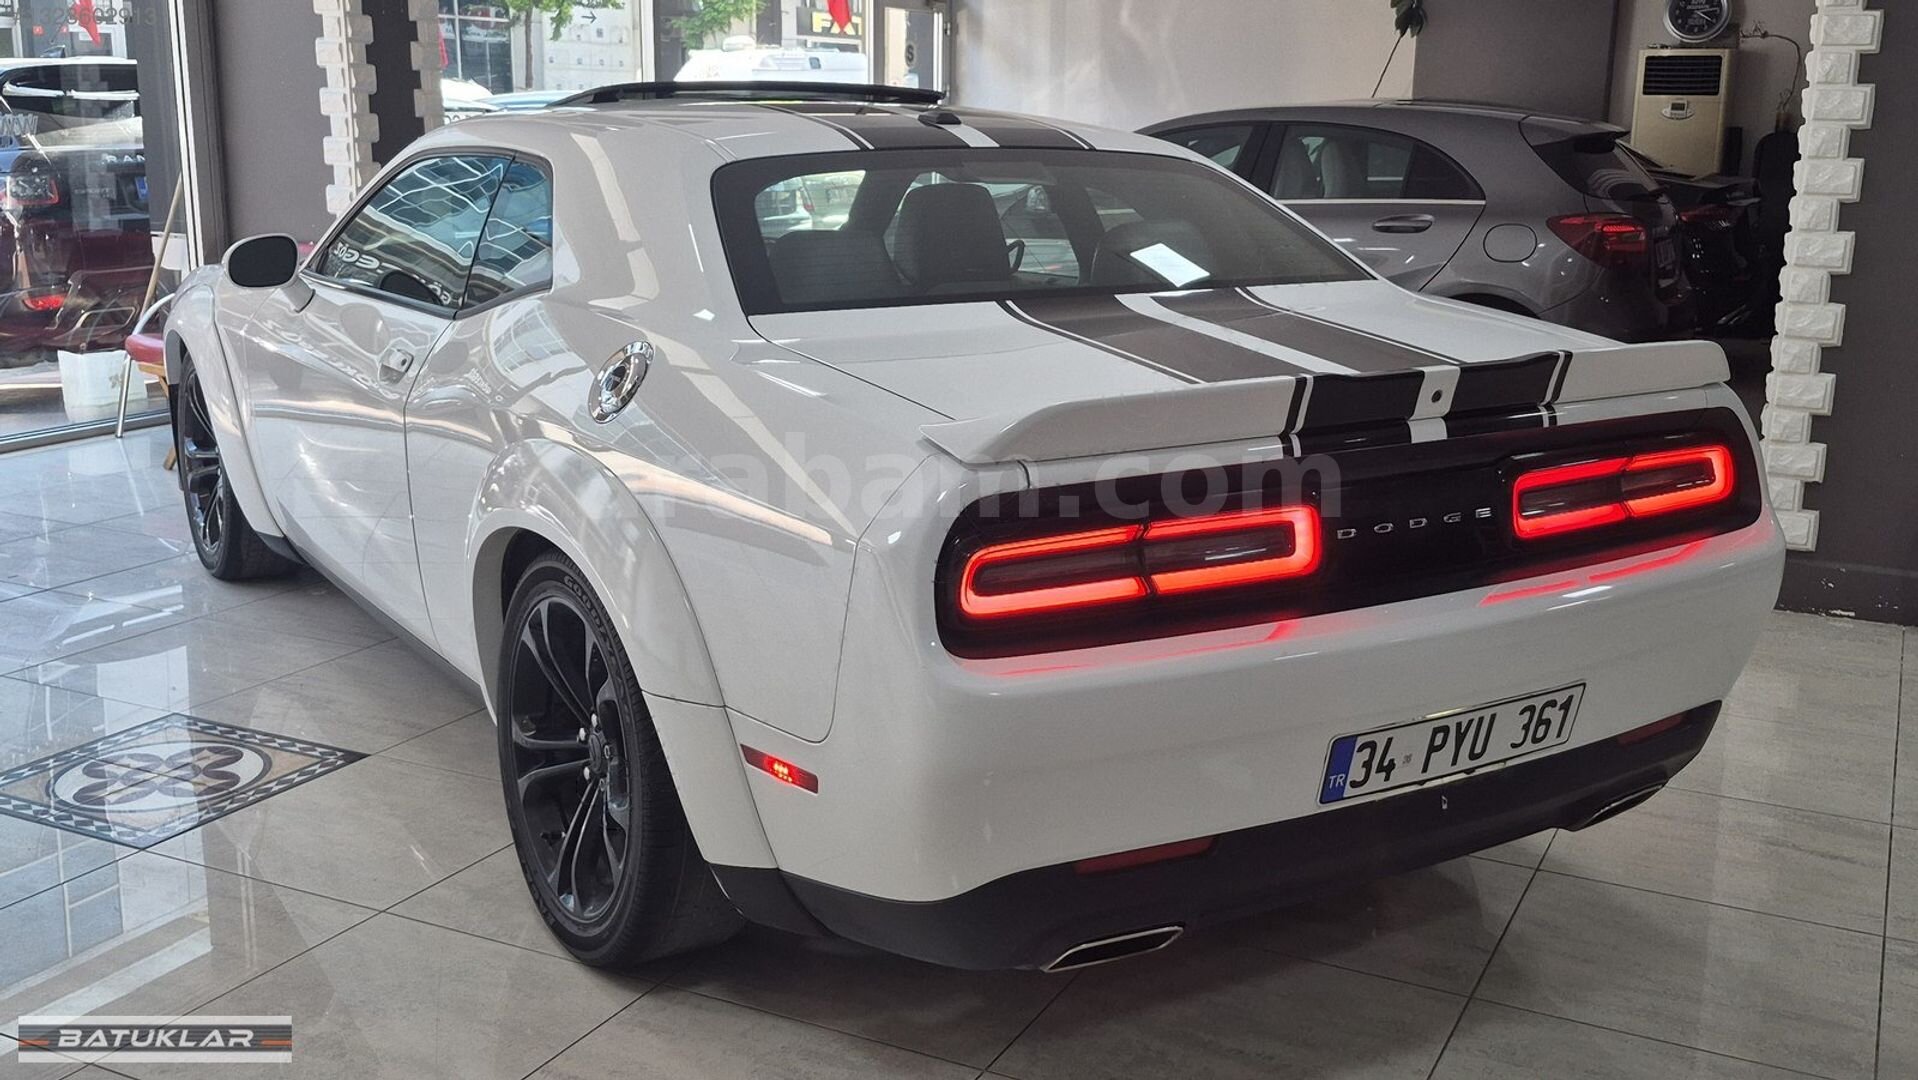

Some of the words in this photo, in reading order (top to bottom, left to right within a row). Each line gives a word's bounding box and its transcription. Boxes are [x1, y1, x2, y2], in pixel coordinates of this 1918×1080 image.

[1337, 507, 1492, 539] DODGE
[1349, 736, 1397, 789] 34
[1421, 712, 1498, 775] PYU
[1510, 694, 1575, 750] 361
[1328, 773, 1345, 790] TR
